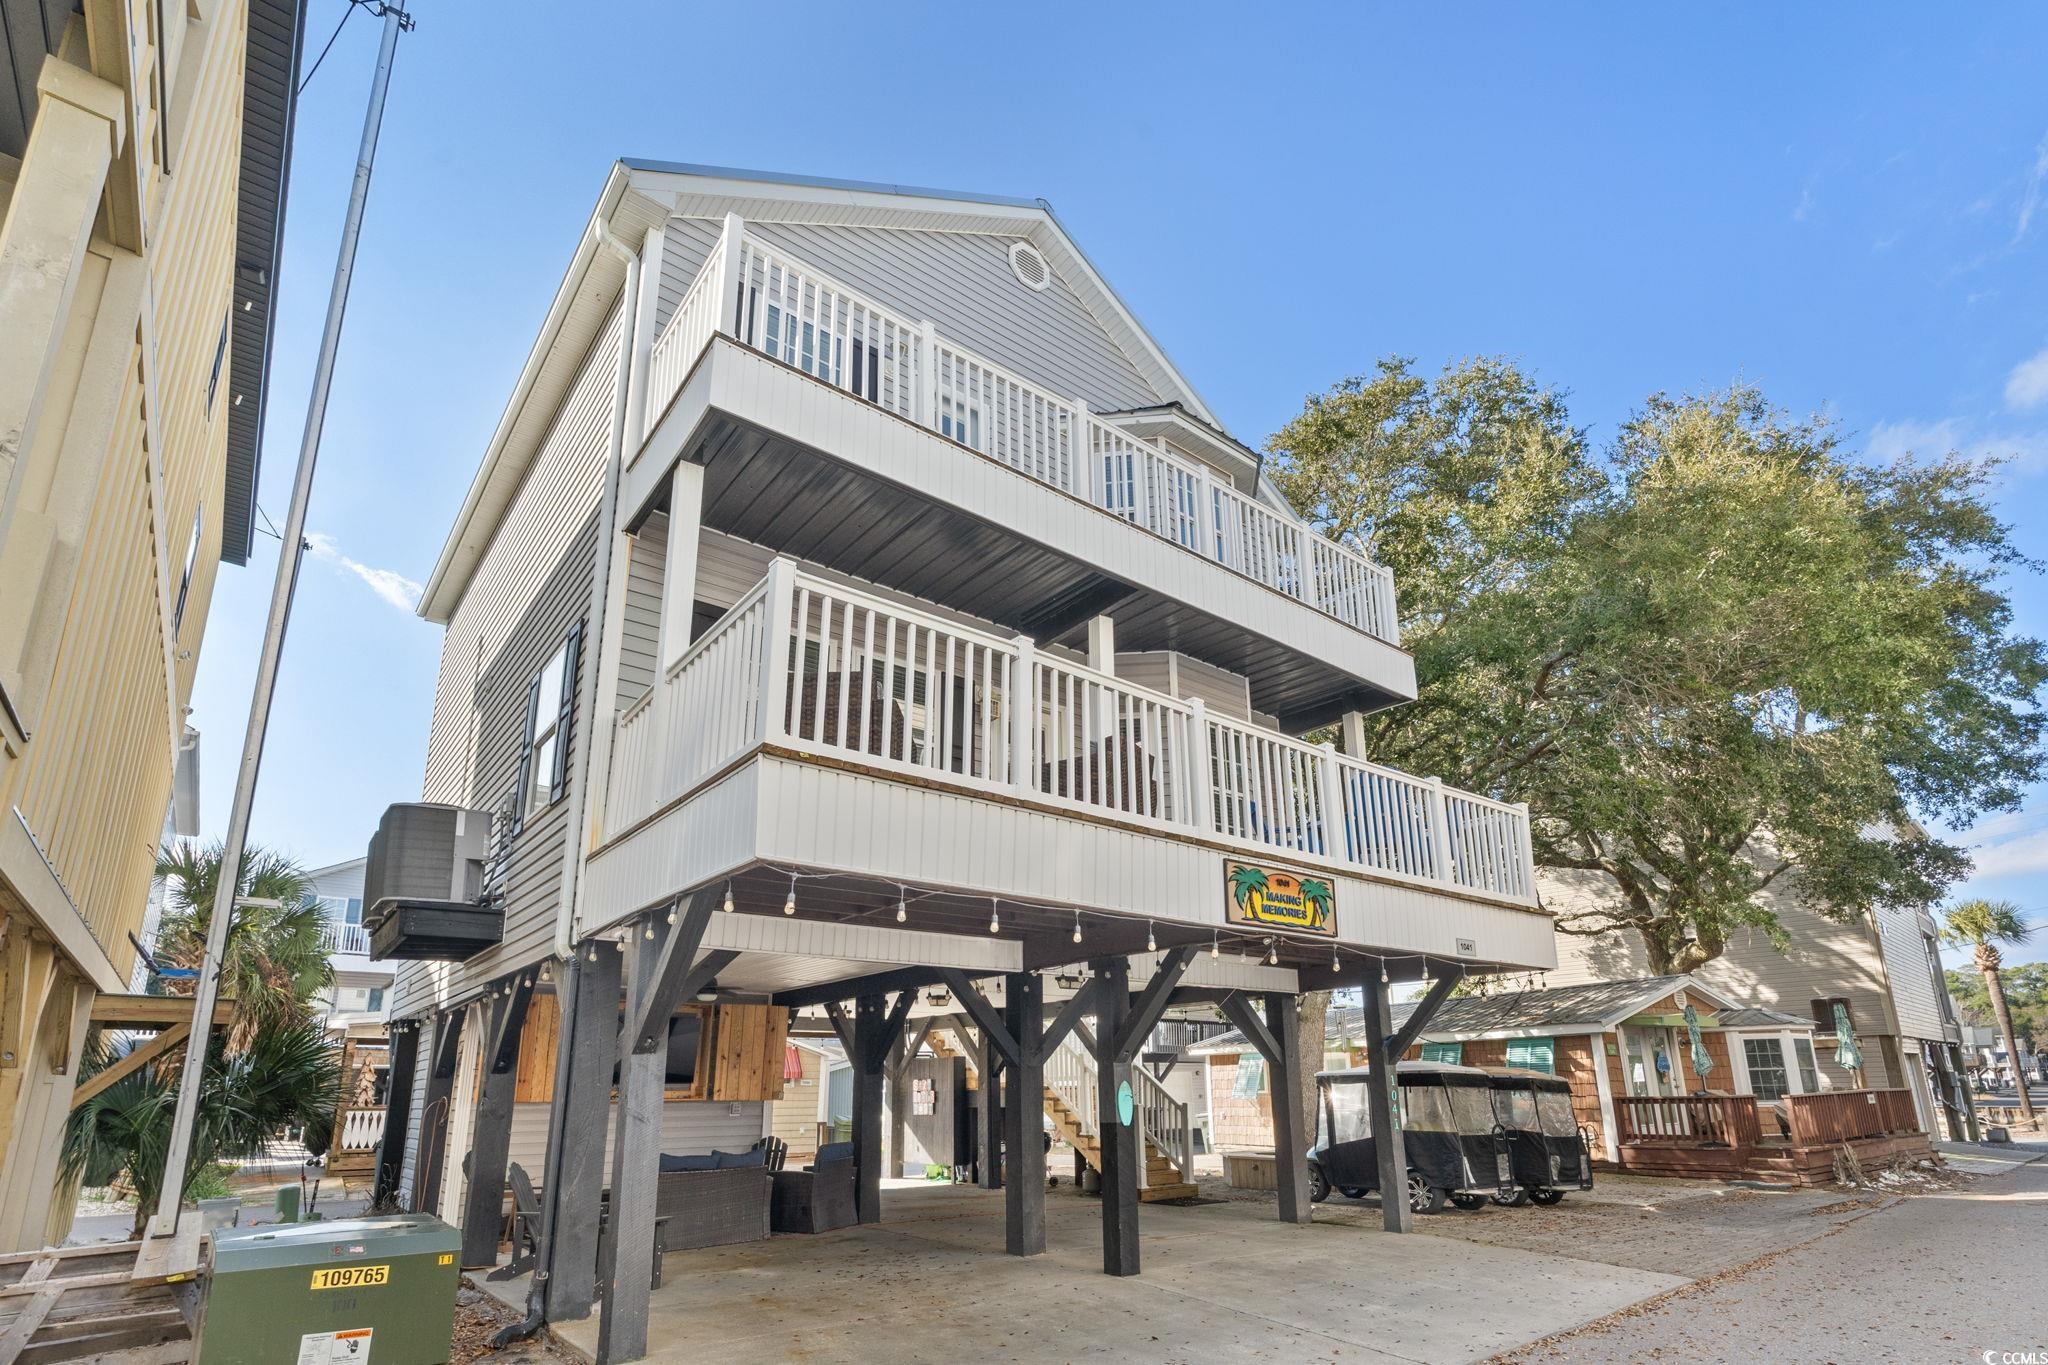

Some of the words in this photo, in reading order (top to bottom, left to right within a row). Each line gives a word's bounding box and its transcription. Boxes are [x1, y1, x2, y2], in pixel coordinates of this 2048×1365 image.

[1265, 891, 1302, 907] MAKING
[1261, 904, 1308, 920] MEMORIES
[321, 1267, 385, 1287] 109765
[343, 1330, 370, 1339] WARNING
